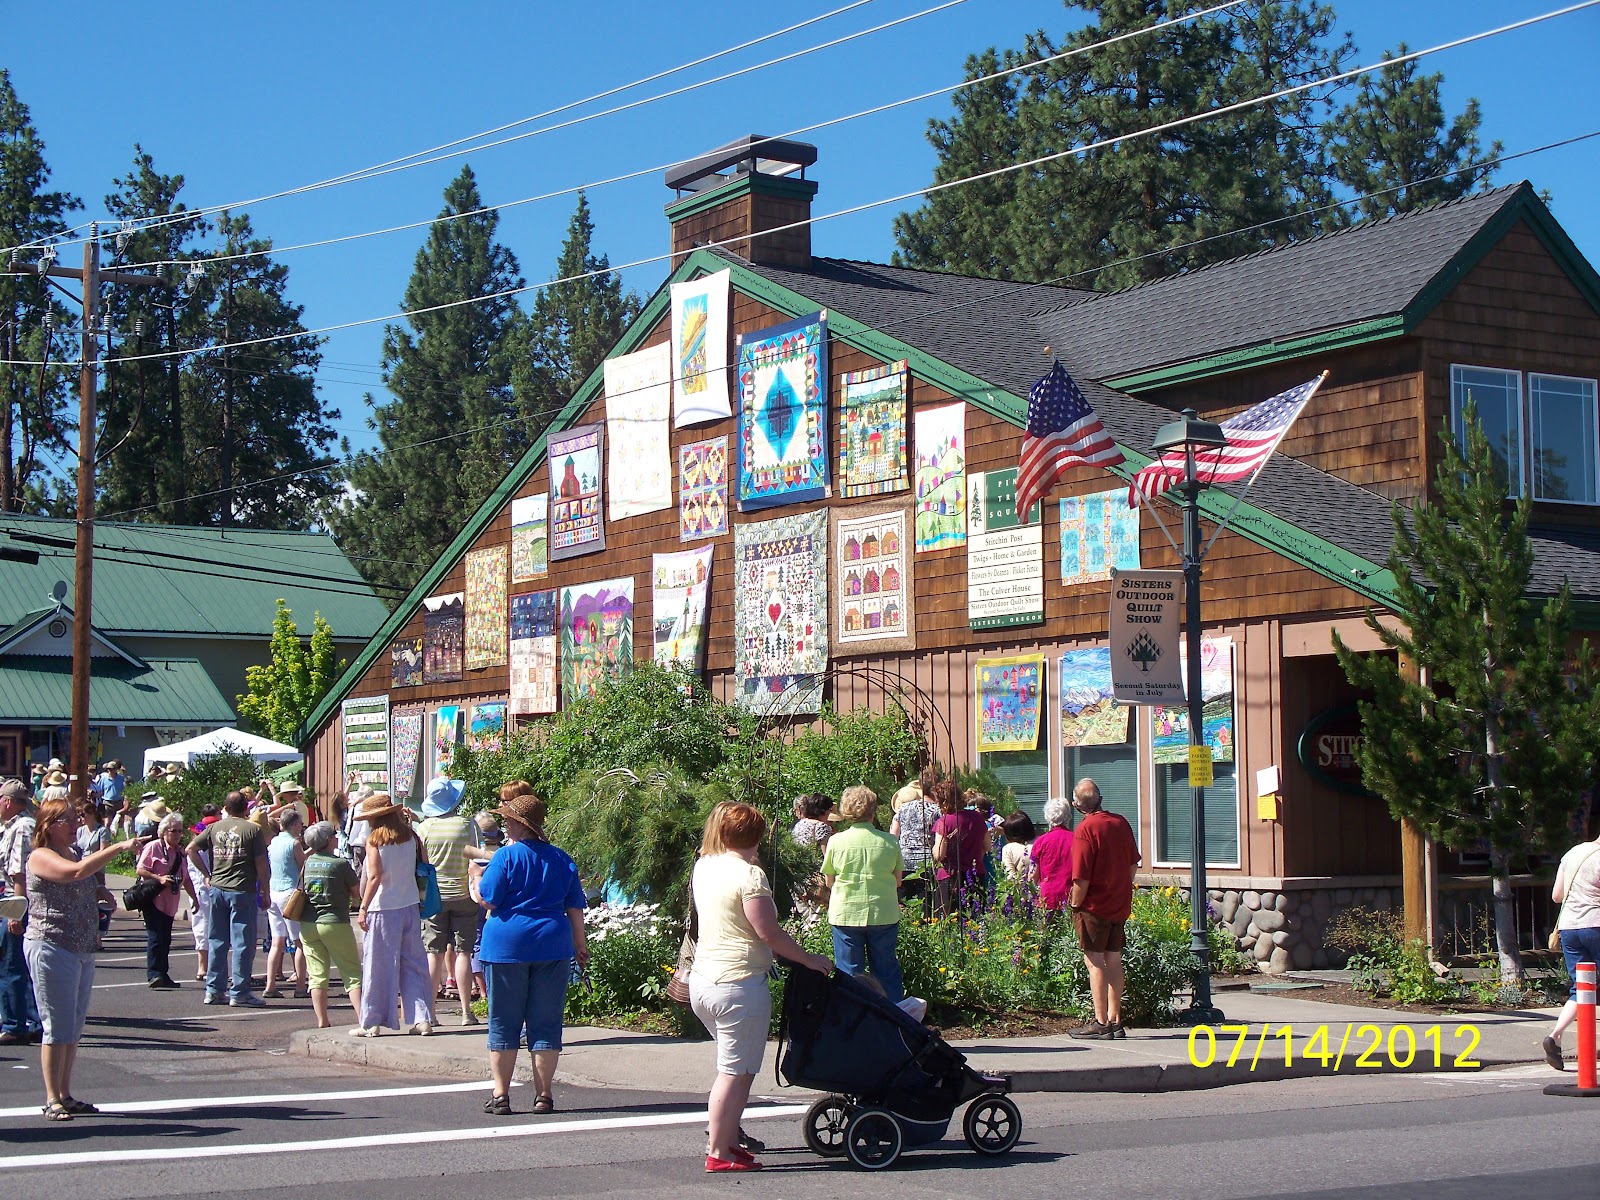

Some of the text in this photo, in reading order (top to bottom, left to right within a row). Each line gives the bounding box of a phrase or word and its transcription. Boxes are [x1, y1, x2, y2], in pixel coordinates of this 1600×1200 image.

[989, 504, 1035, 519] SQUAE
[1010, 534, 1023, 543] Post
[973, 554, 988, 564] Twigs
[993, 552, 1009, 560] Home
[1016, 549, 1037, 557] Garden
[979, 585, 1031, 597] The Culver House
[971, 596, 1039, 610] Sisters Outdoor Quilt Show
[969, 614, 1042, 627] SISTERS, OREGON
[1145, 682, 1181, 690] Saturday
